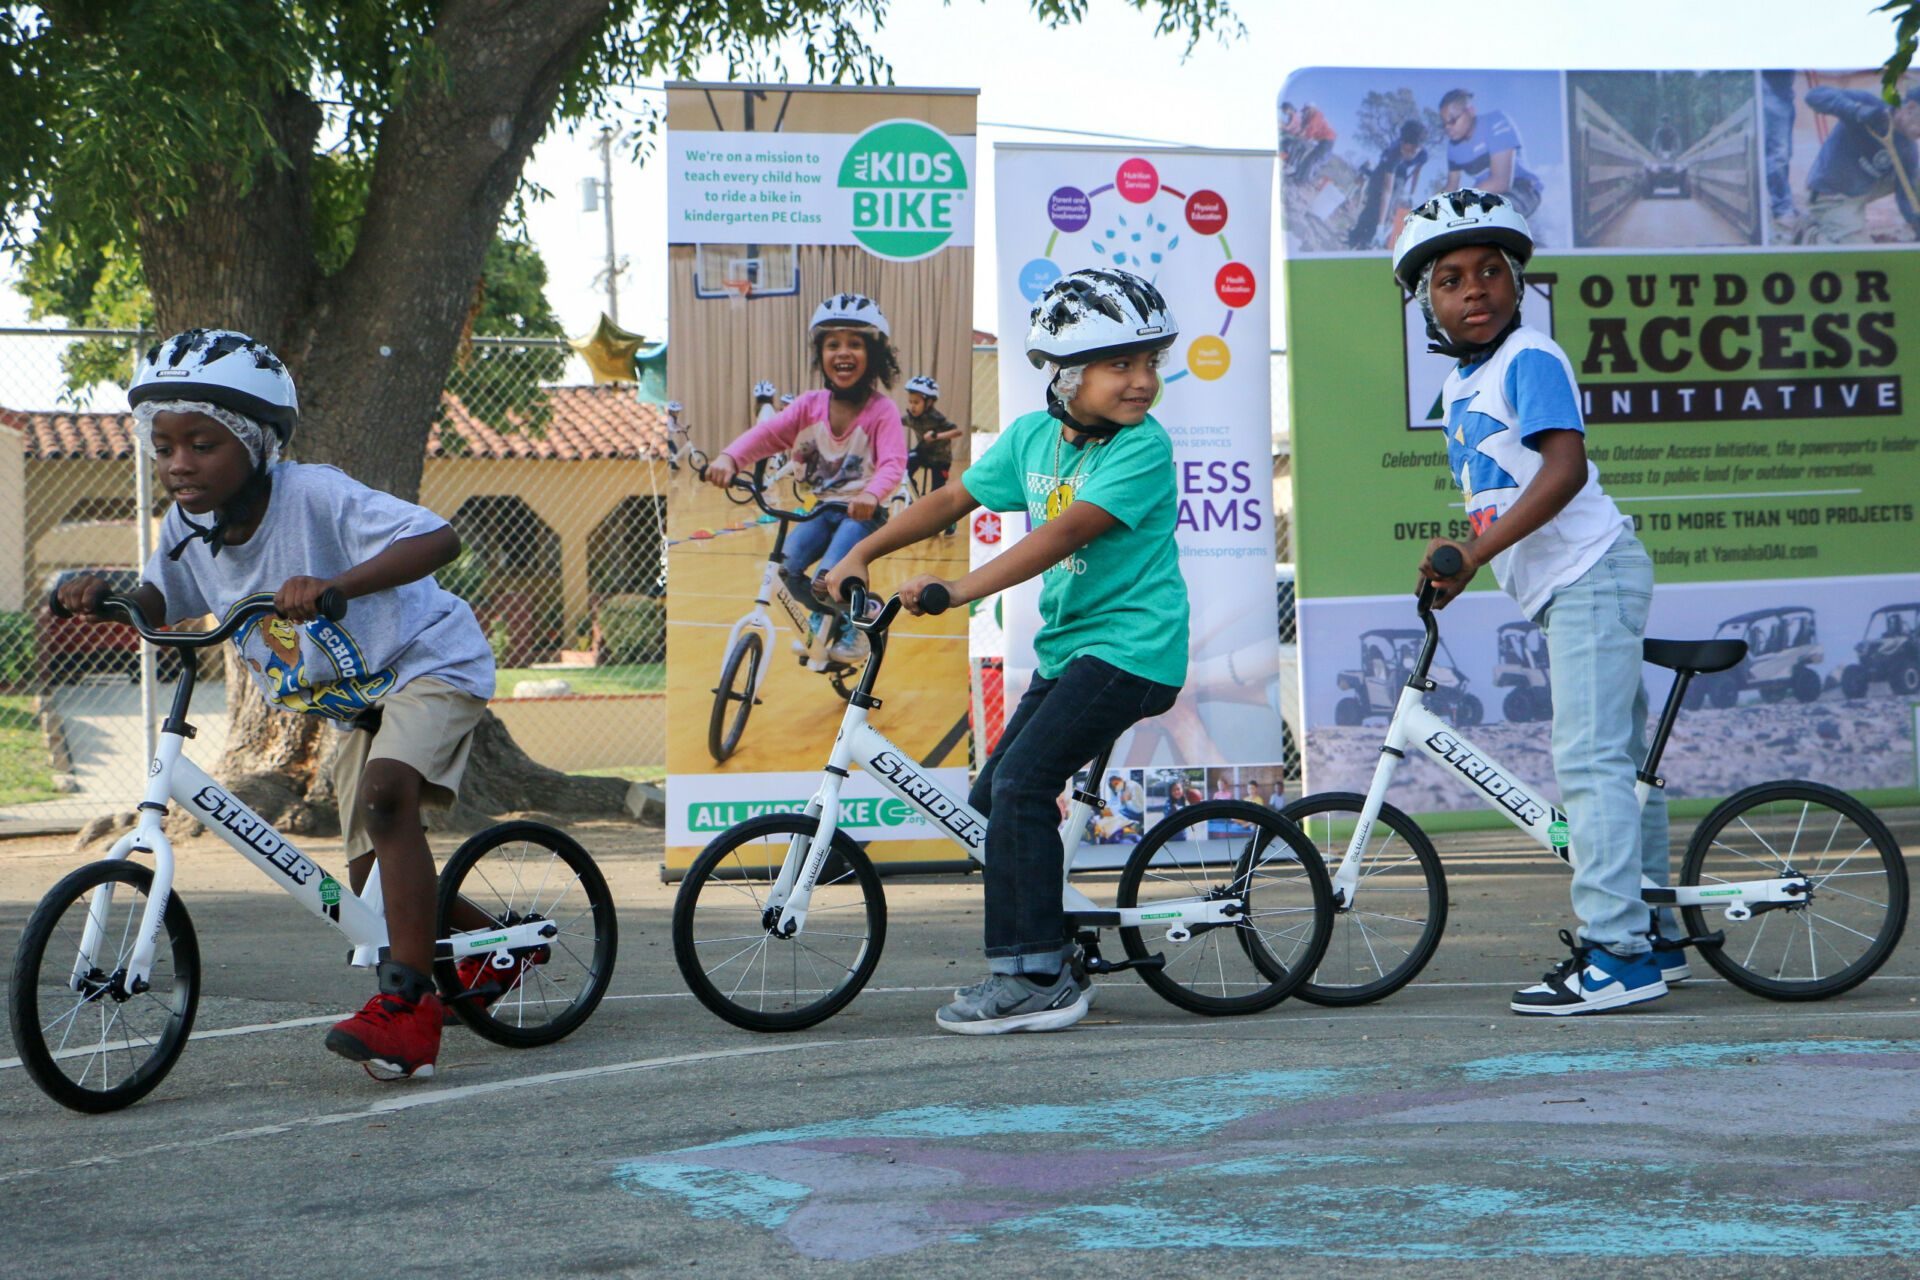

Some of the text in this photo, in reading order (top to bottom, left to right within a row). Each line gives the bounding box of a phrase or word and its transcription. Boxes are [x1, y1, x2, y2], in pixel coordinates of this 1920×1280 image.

[685, 149, 820, 164] We're on a mission to
[854, 151, 953, 183] ALL KIDS
[684, 170, 821, 185] teach every child how
[1123, 172, 1151, 180] Nutrition
[1124, 180, 1150, 189] Services
[704, 190, 802, 203] to ride a bike in
[1051, 203, 1087, 213] Community
[1052, 195, 1086, 204] Parent and
[1193, 203, 1219, 212] Physical
[684, 209, 822, 225] kindergarten PE Class
[853, 191, 952, 228] BIKE
[1051, 212, 1088, 221] Involvement
[1191, 212, 1222, 221] Education
[1579, 270, 1891, 308] OUTDOOR
[1581, 312, 1898, 374] ACCESS
[1584, 383, 1896, 415] INITIATIVE
[1190, 439, 1231, 448] SERVICES
[1612, 444, 1664, 461] Outdoor
[1666, 443, 1712, 459] Access
[1776, 440, 1797, 456] the
[1798, 437, 1878, 459] powersports
[1881, 436, 1920, 452] leader
[1174, 460, 1251, 494] ESS
[1434, 475, 1446, 490] in
[1647, 469, 1661, 484] to
[1663, 466, 1700, 486] public
[1703, 464, 1731, 482] land
[1732, 464, 1754, 484] for
[1756, 464, 1806, 480] outdoor
[1175, 498, 1262, 531] AMS
[1394, 520, 1442, 540] OVER
[1648, 513, 1671, 530] TO
[1677, 511, 1728, 530] MORE
[1732, 509, 1781, 528] THAN
[1786, 507, 1821, 526] 400
[1826, 504, 1914, 524] PROJECTS
[1180, 545, 1267, 558] ellnessprograms
[1652, 546, 1690, 567] today
[1694, 548, 1708, 563] at
[318, 626, 358, 679] SCHOO
[1425, 731, 1546, 826] STRIDER
[869, 751, 988, 848] STRIDER
[695, 805, 741, 828] ALL
[193, 785, 315, 885] STRIDER
